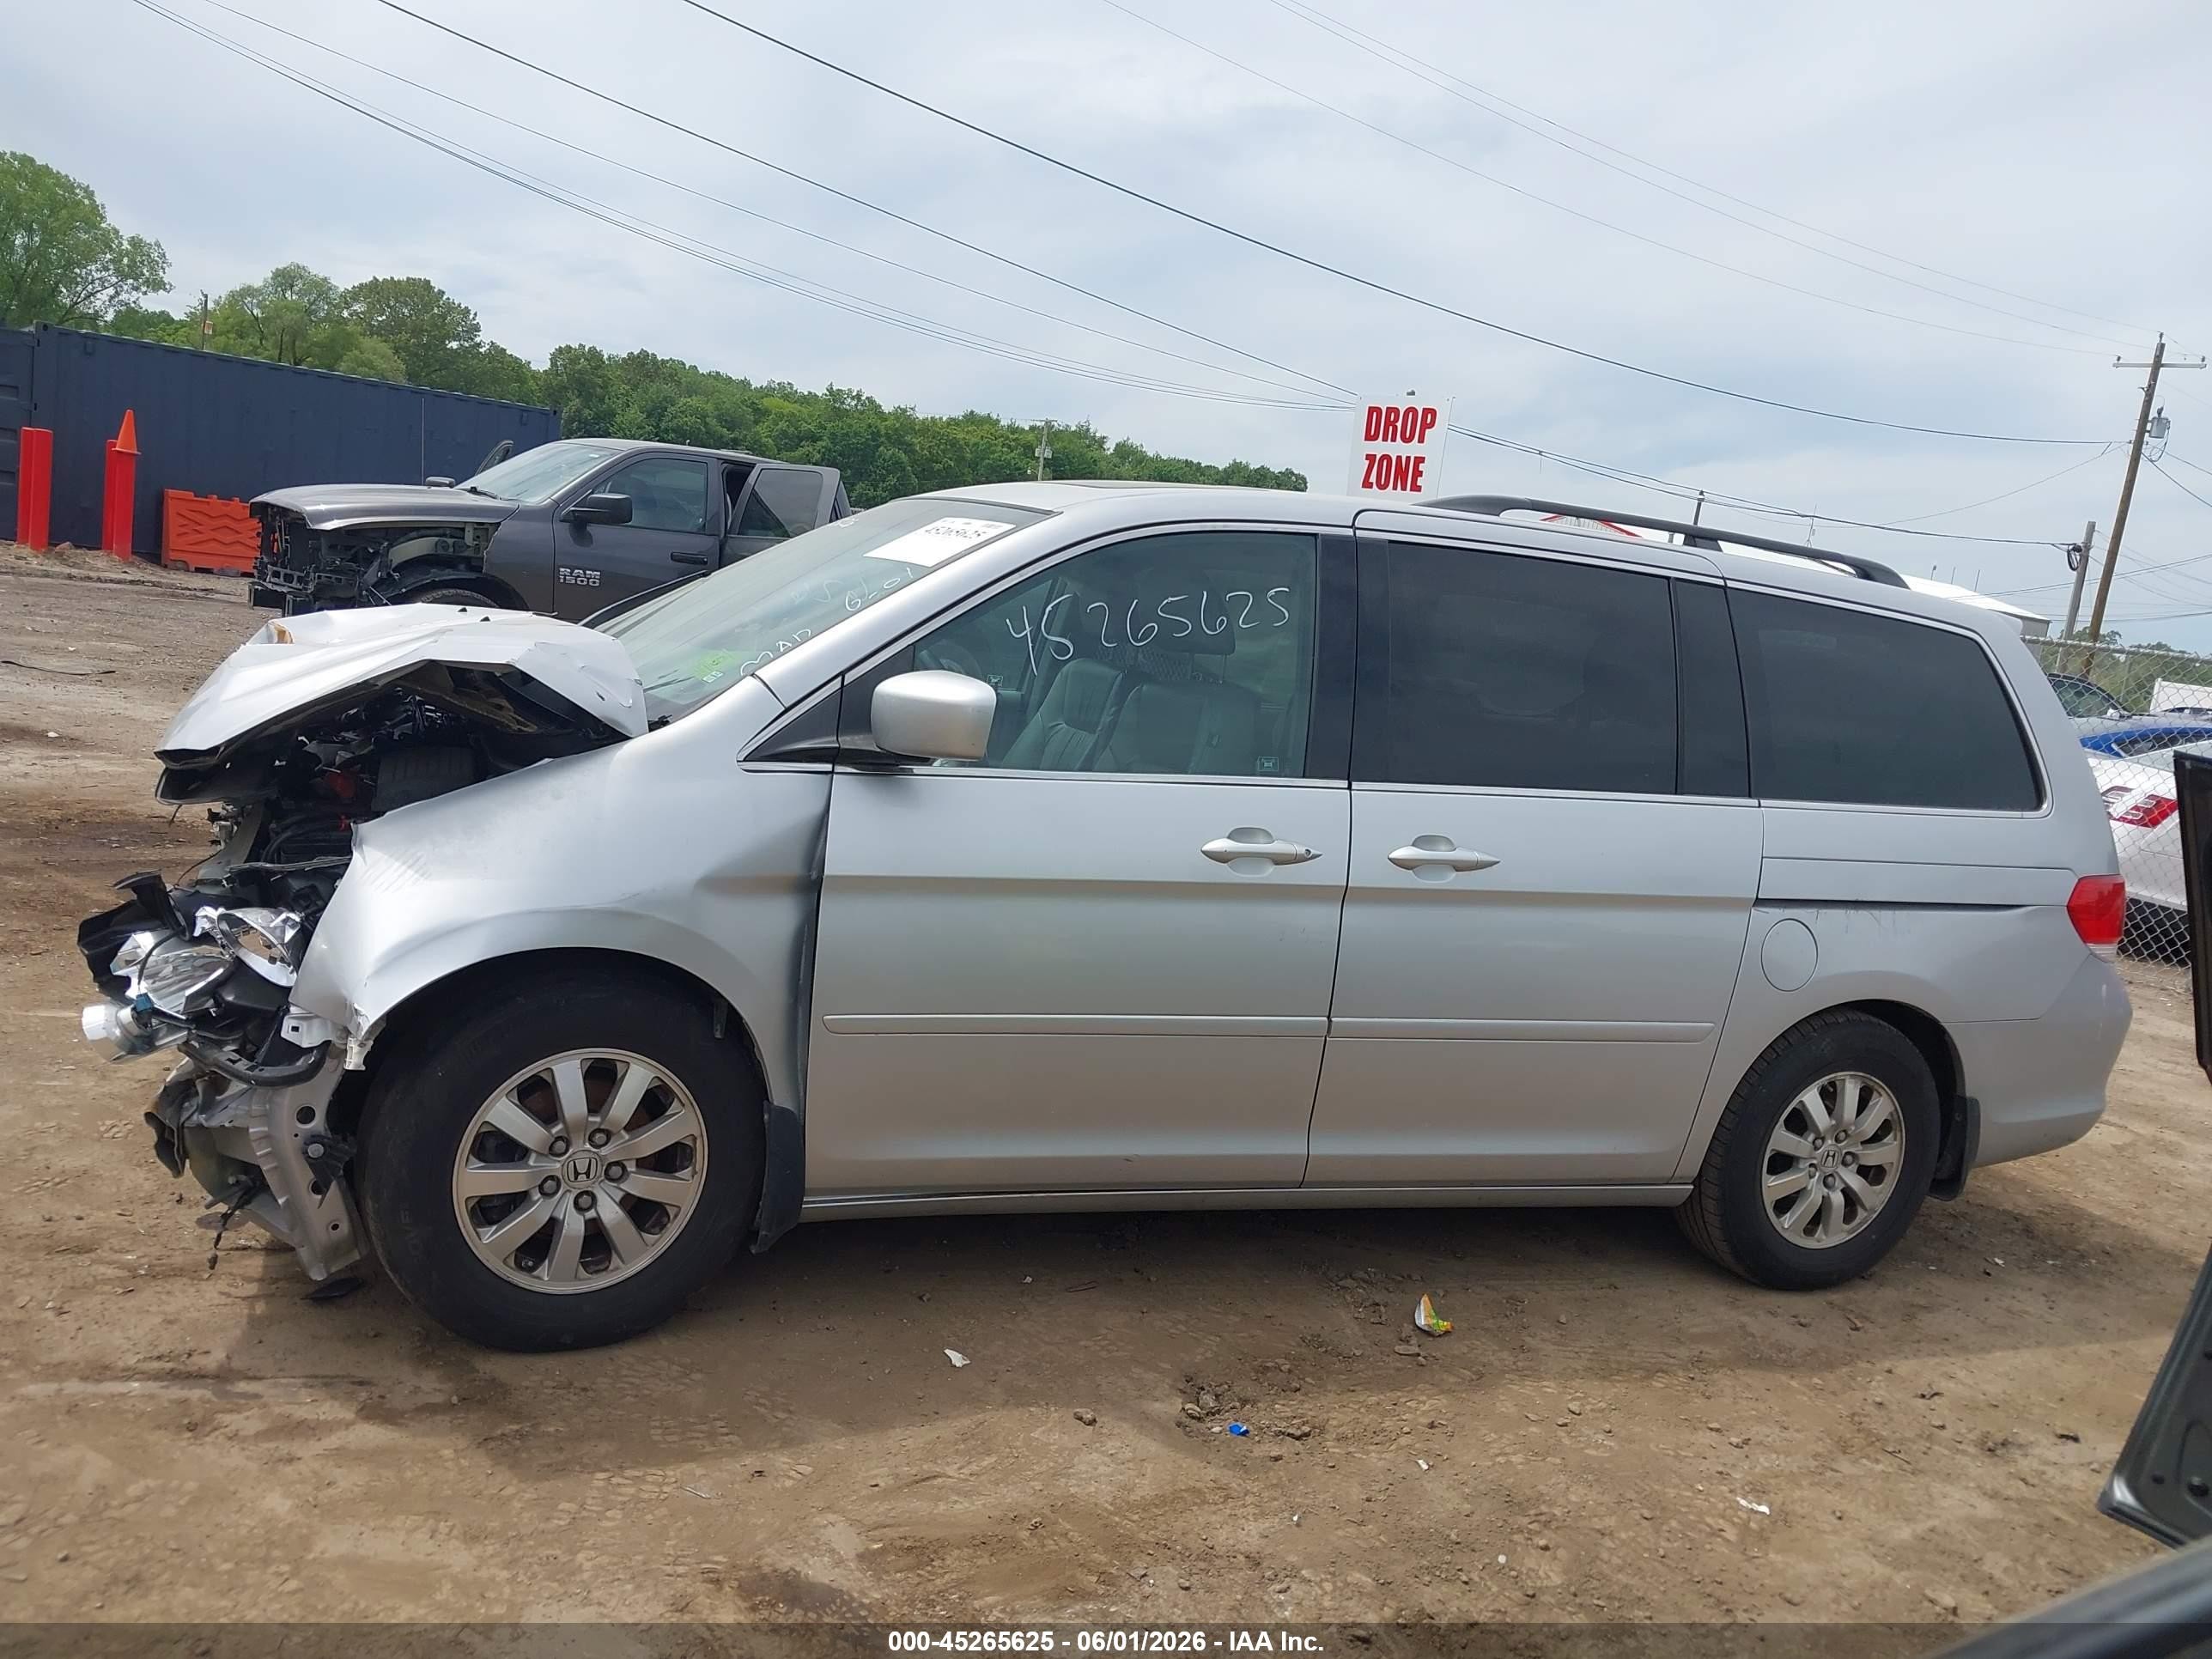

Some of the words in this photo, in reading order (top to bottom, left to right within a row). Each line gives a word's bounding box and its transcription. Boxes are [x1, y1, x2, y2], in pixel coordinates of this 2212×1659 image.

[1364, 405, 1437, 444] DROP
[1361, 453, 1426, 493] ZONE
[558, 567, 601, 579] RAM
[558, 575, 600, 586] 1500
